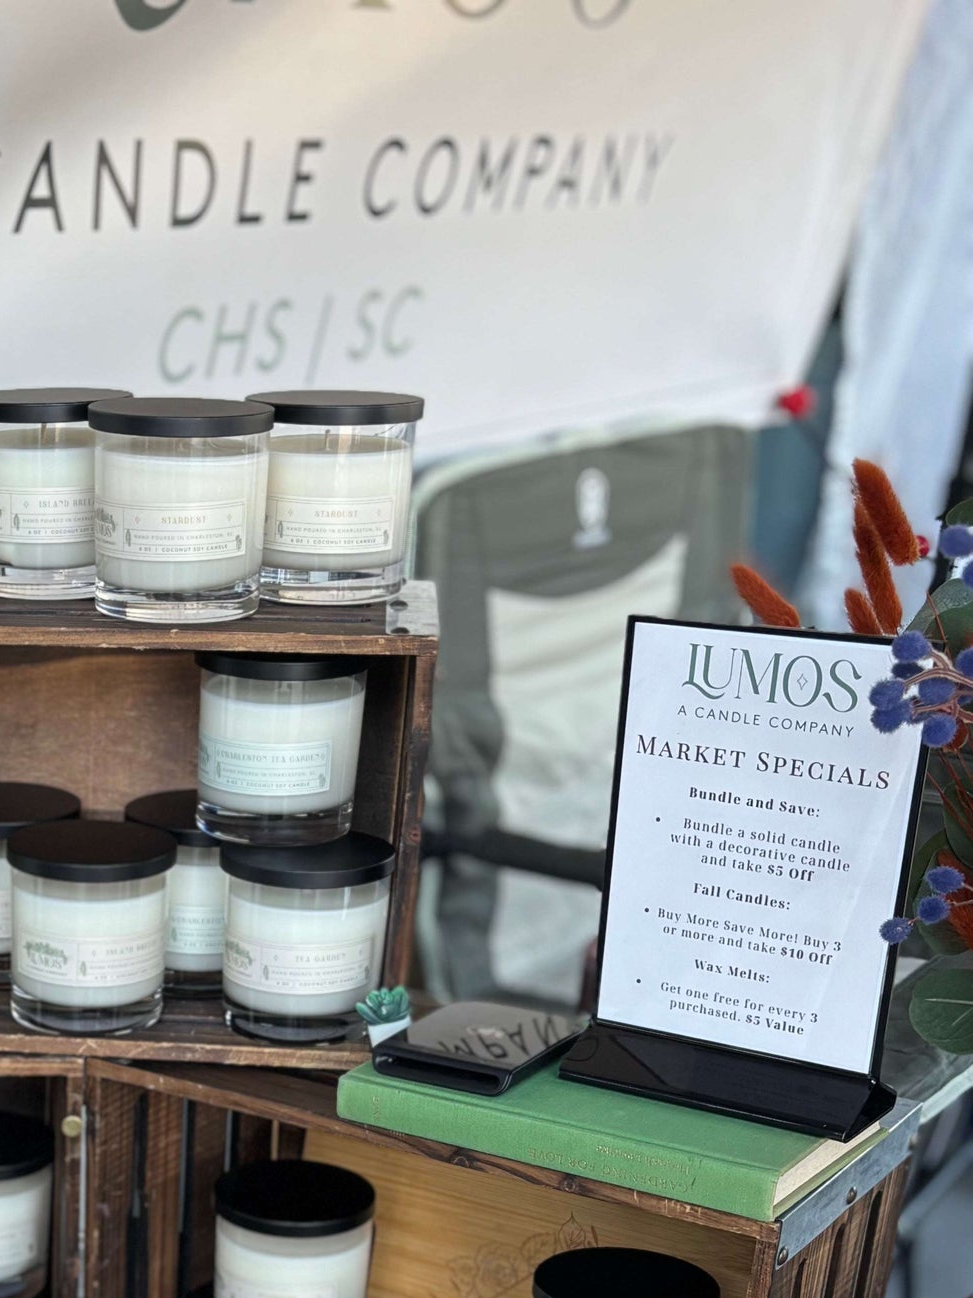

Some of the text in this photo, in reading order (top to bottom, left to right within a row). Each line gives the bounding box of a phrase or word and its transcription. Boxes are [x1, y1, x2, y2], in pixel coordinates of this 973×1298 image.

[363, 134, 676, 220] COMPANY
[156, 299, 293, 385] CHS
[347, 285, 424, 362] SC
[682, 643, 862, 713] LUMOS
[677, 705, 854, 737] A CANDLE COMPANY
[637, 735, 890, 789] MARKET SPECIALS
[689, 787, 819, 817] Bundle and Save:
[671, 833, 701, 847] with
[719, 839, 795, 863] decorative
[800, 855, 850, 872] candle
[683, 818, 840, 854] Bundle a solid candle
[701, 854, 814, 882] and take $5 Off
[693, 883, 790, 910] Fall Candles:
[658, 908, 841, 952] Buy More Save More! Buy 3
[663, 925, 832, 965] or more and take $10 Off
[695, 959, 770, 983] Wax Melts:
[661, 982, 818, 1023] Get one free for every 3
[670, 999, 804, 1035] purchased. $5 Value
